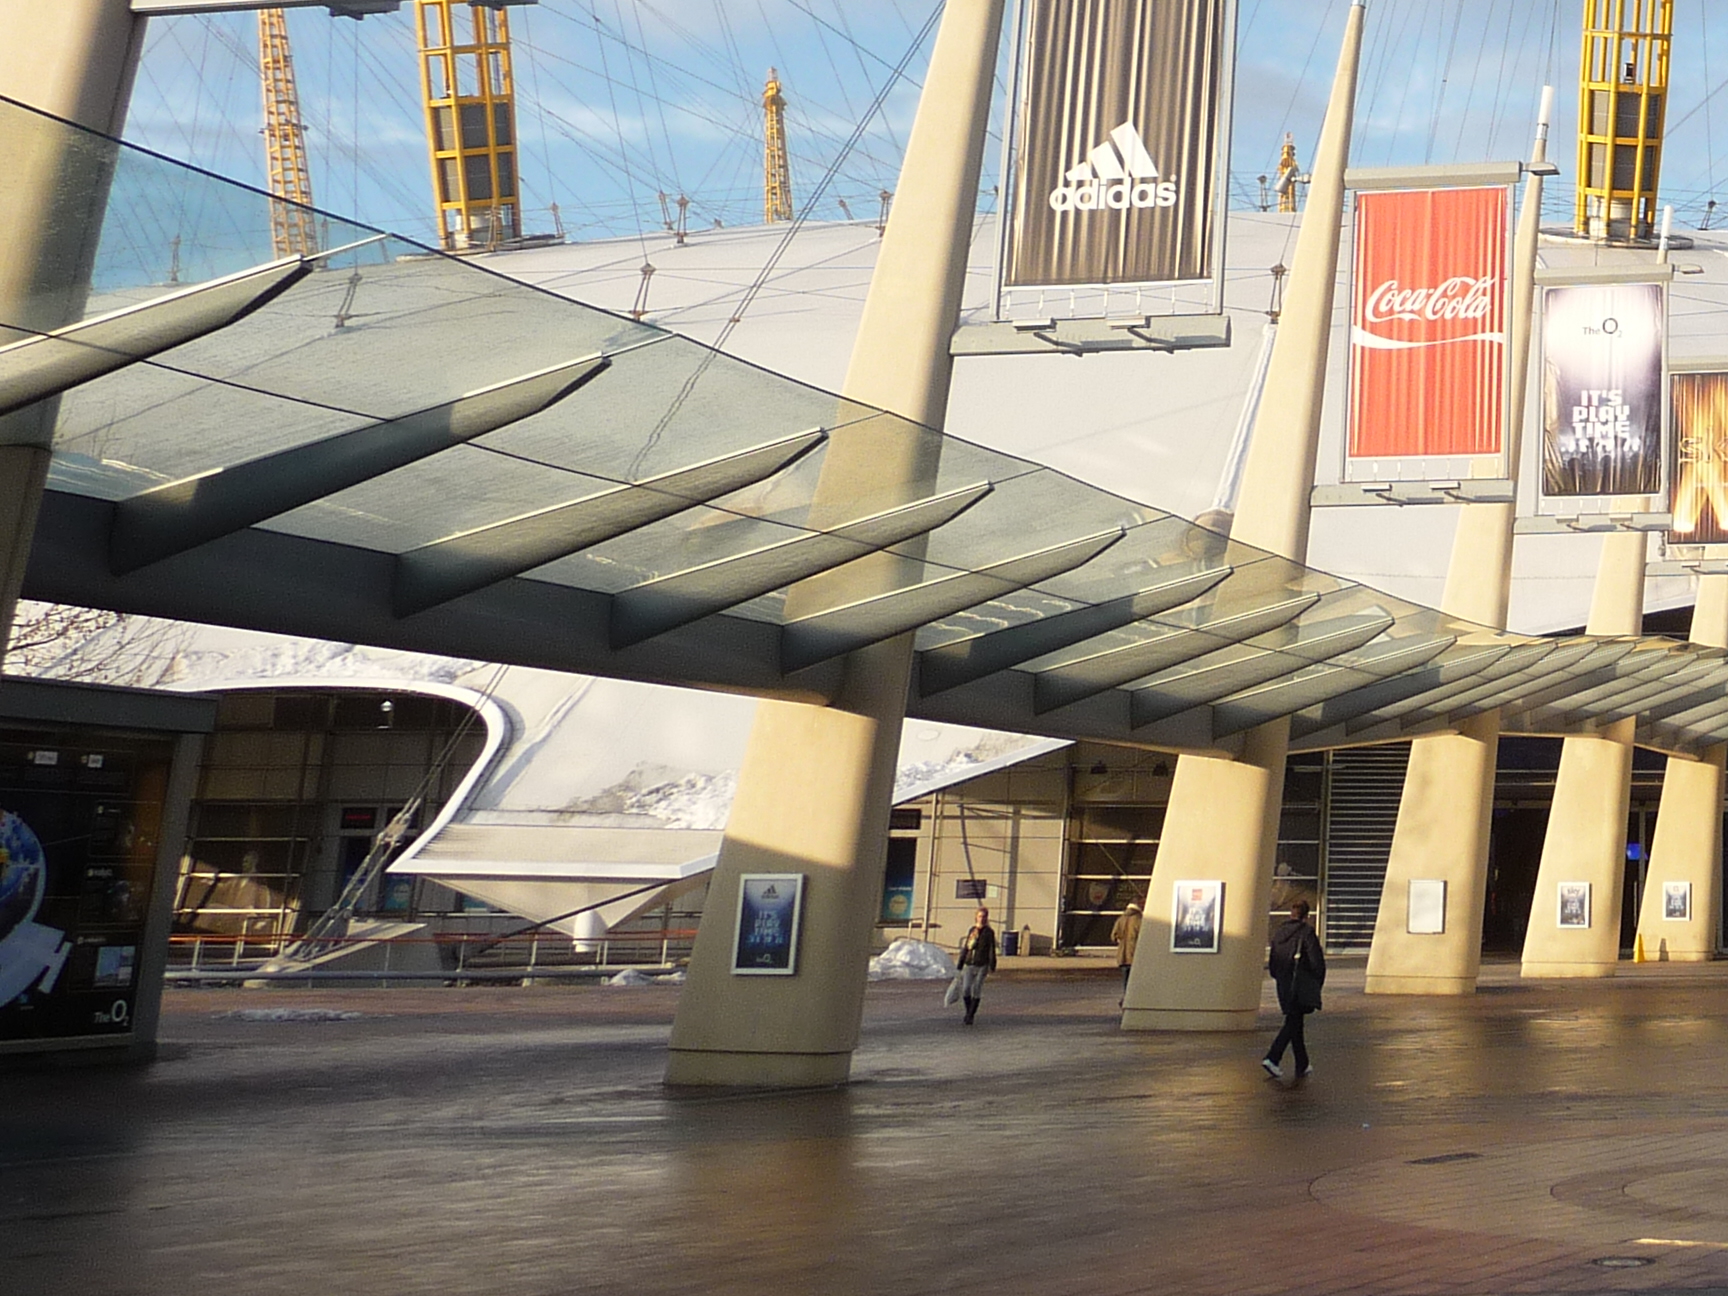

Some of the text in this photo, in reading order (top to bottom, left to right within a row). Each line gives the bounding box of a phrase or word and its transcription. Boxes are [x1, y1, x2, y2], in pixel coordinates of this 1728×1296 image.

[1049, 176, 1178, 212] adidas
[1365, 277, 1498, 323] Coca-Cola
[1582, 326, 1600, 336] The
[1580, 389, 1623, 406] IT'S
[1572, 405, 1630, 422] PLAY
[1573, 421, 1630, 439] TIME
